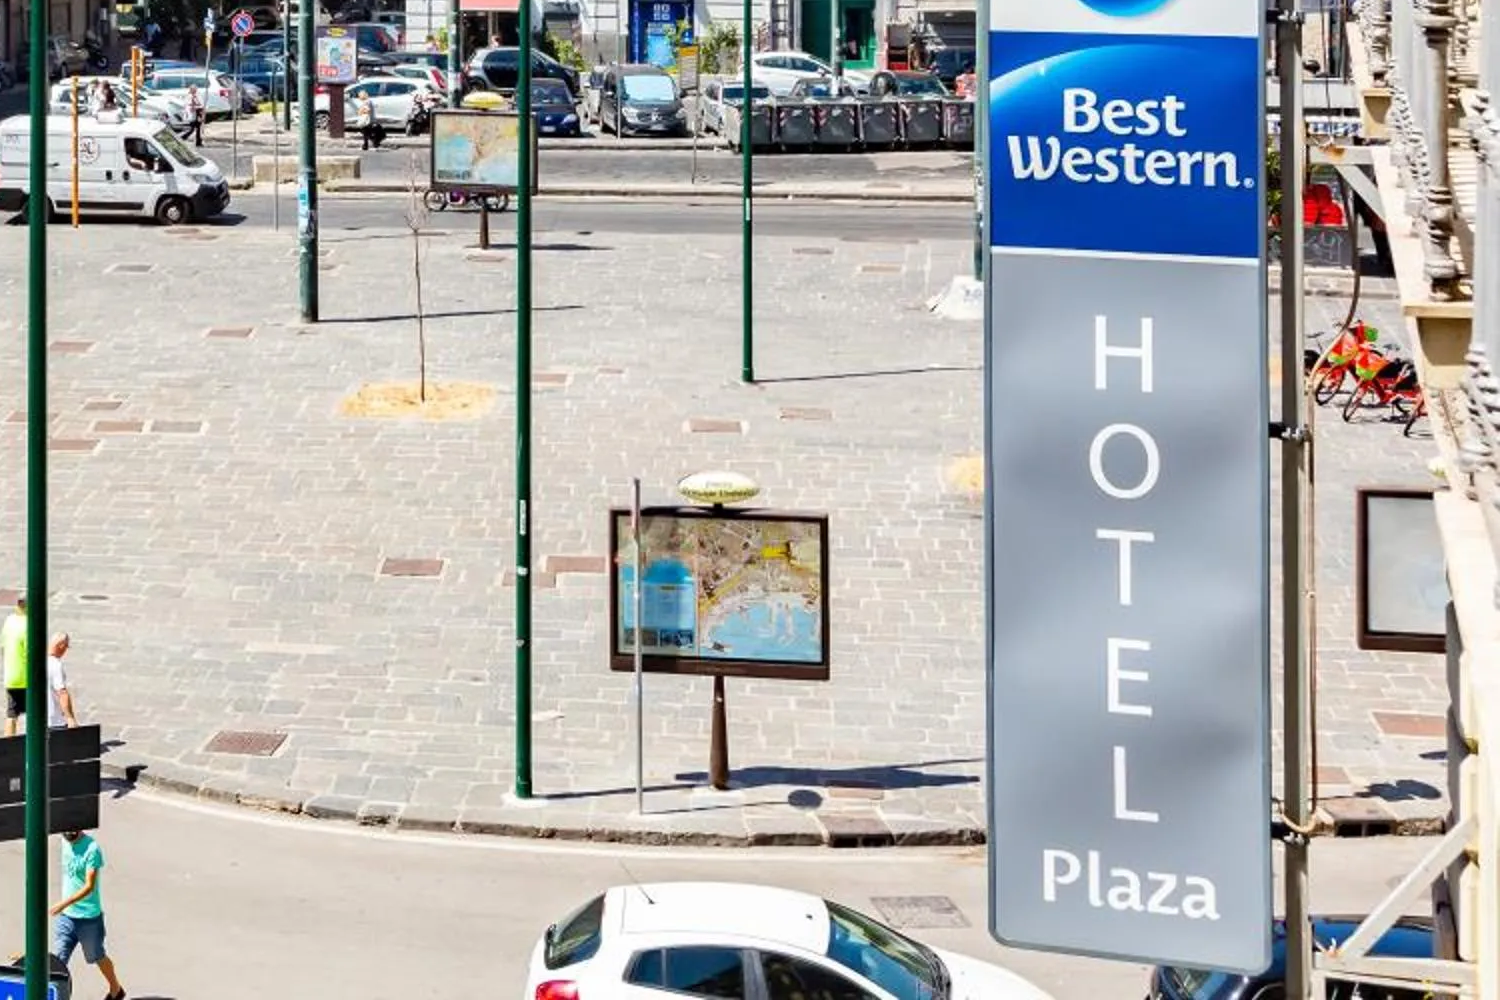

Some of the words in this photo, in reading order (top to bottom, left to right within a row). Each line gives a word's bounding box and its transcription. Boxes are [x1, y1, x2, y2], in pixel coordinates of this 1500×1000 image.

[1063, 88, 1187, 137] Best
[1007, 136, 1240, 188] Western
[1089, 315, 1161, 823] HOTEL
[1043, 849, 1221, 920] Plaza
